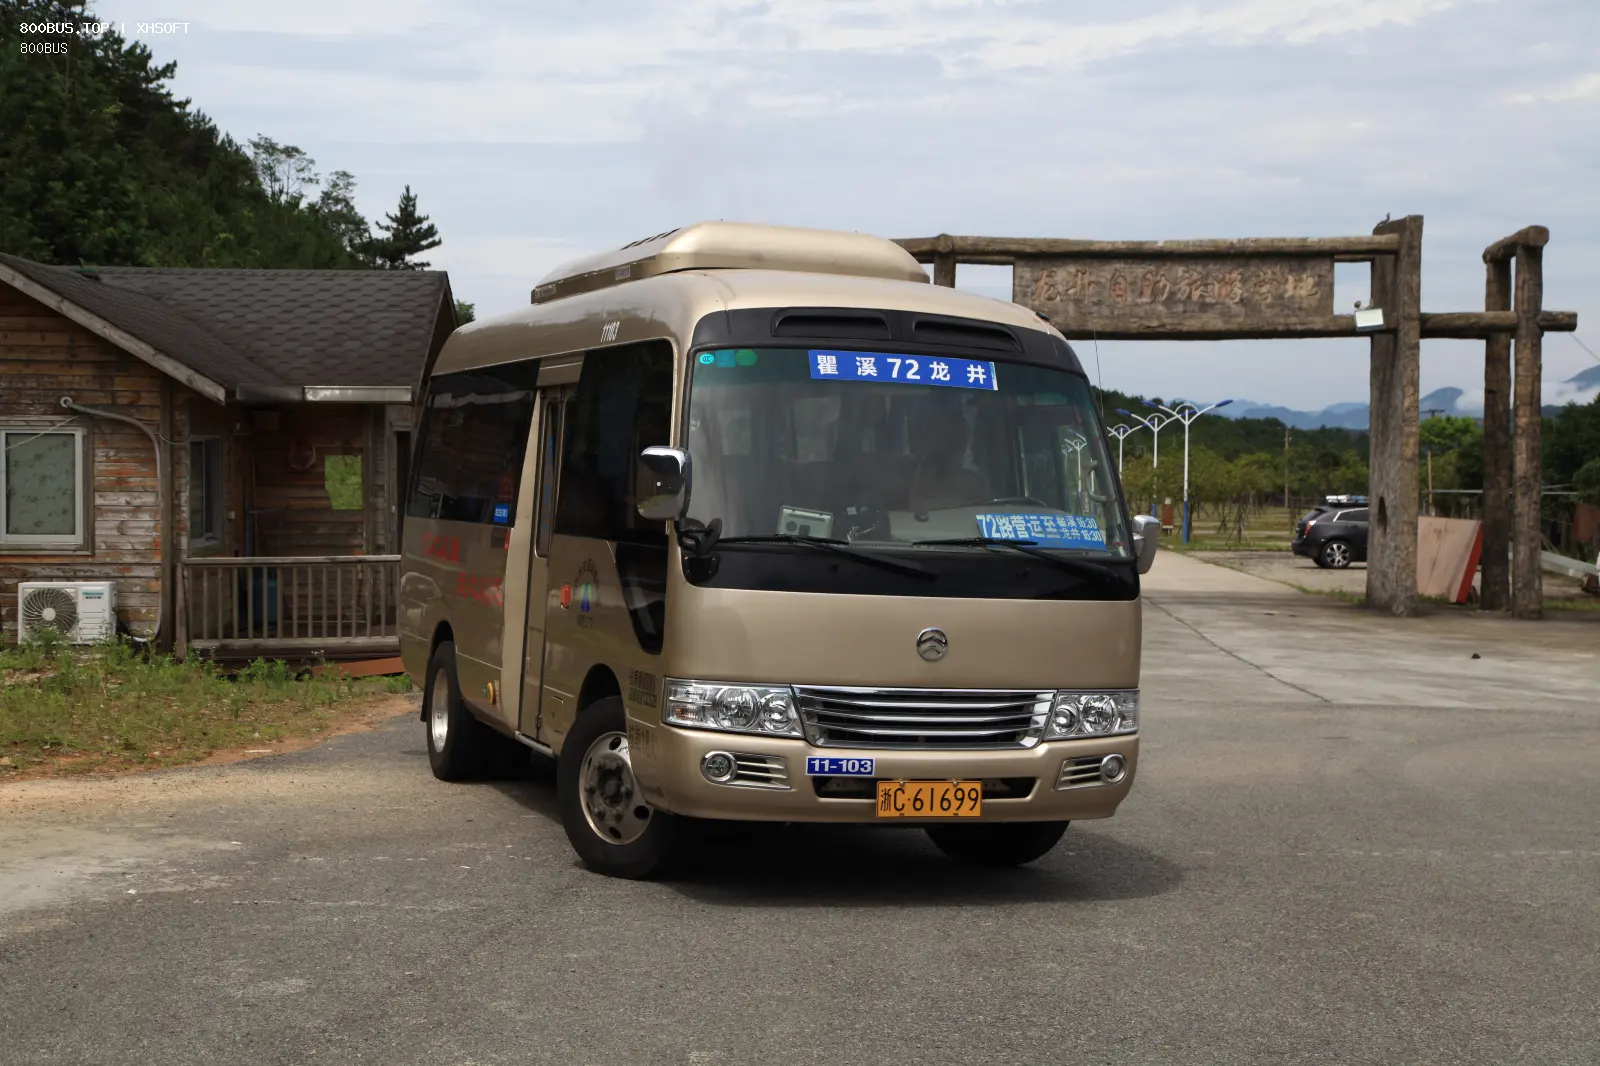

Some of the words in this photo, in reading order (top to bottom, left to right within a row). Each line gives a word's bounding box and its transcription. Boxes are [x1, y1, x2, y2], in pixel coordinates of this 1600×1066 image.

[600, 321, 620, 342] 11103
[886, 358, 921, 380] 72
[929, 361, 987, 385] 龙井
[810, 758, 872, 774] 11-103
